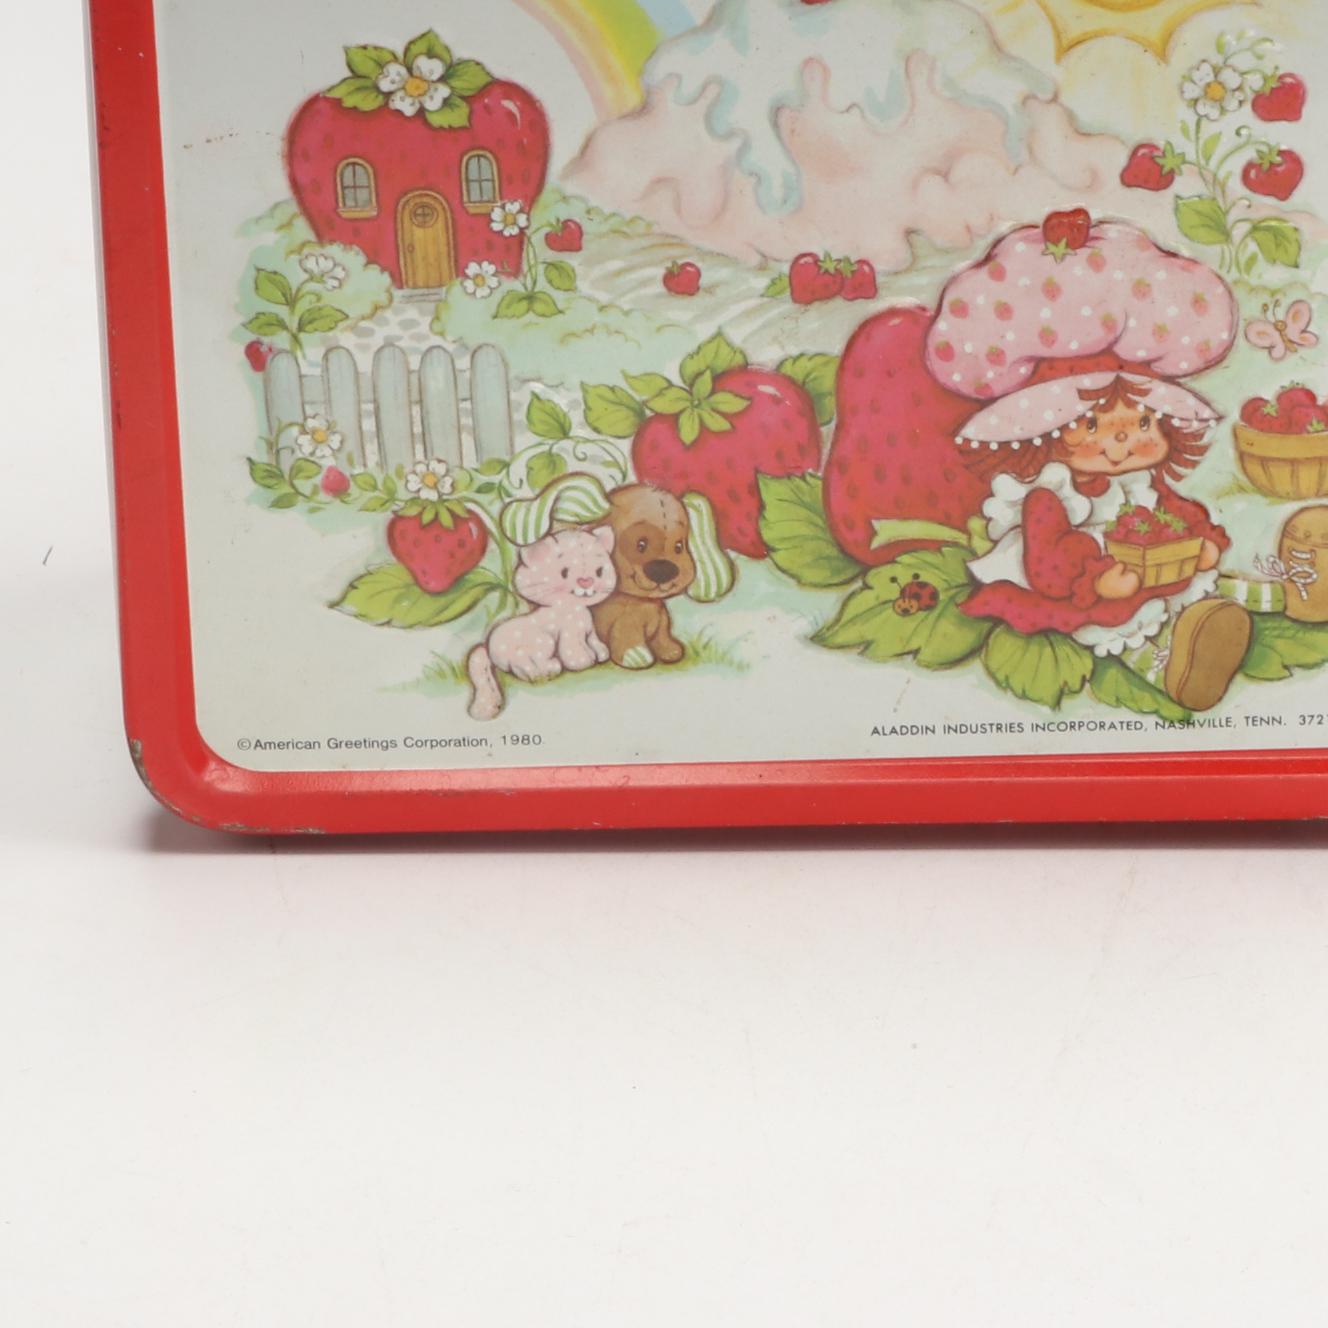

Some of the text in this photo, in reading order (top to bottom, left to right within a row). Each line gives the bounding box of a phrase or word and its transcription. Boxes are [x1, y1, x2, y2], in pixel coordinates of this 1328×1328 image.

[871, 724, 936, 737] ALADDIN
[943, 722, 1024, 735] INDUSTRIES
[1031, 720, 1148, 734] INCORPORATED,
[1155, 716, 1237, 730] NASHVILLE,
[1244, 714, 1287, 727] TENN.
[327, 736, 398, 752] Greetings
[403, 735, 493, 749] Corporation,
